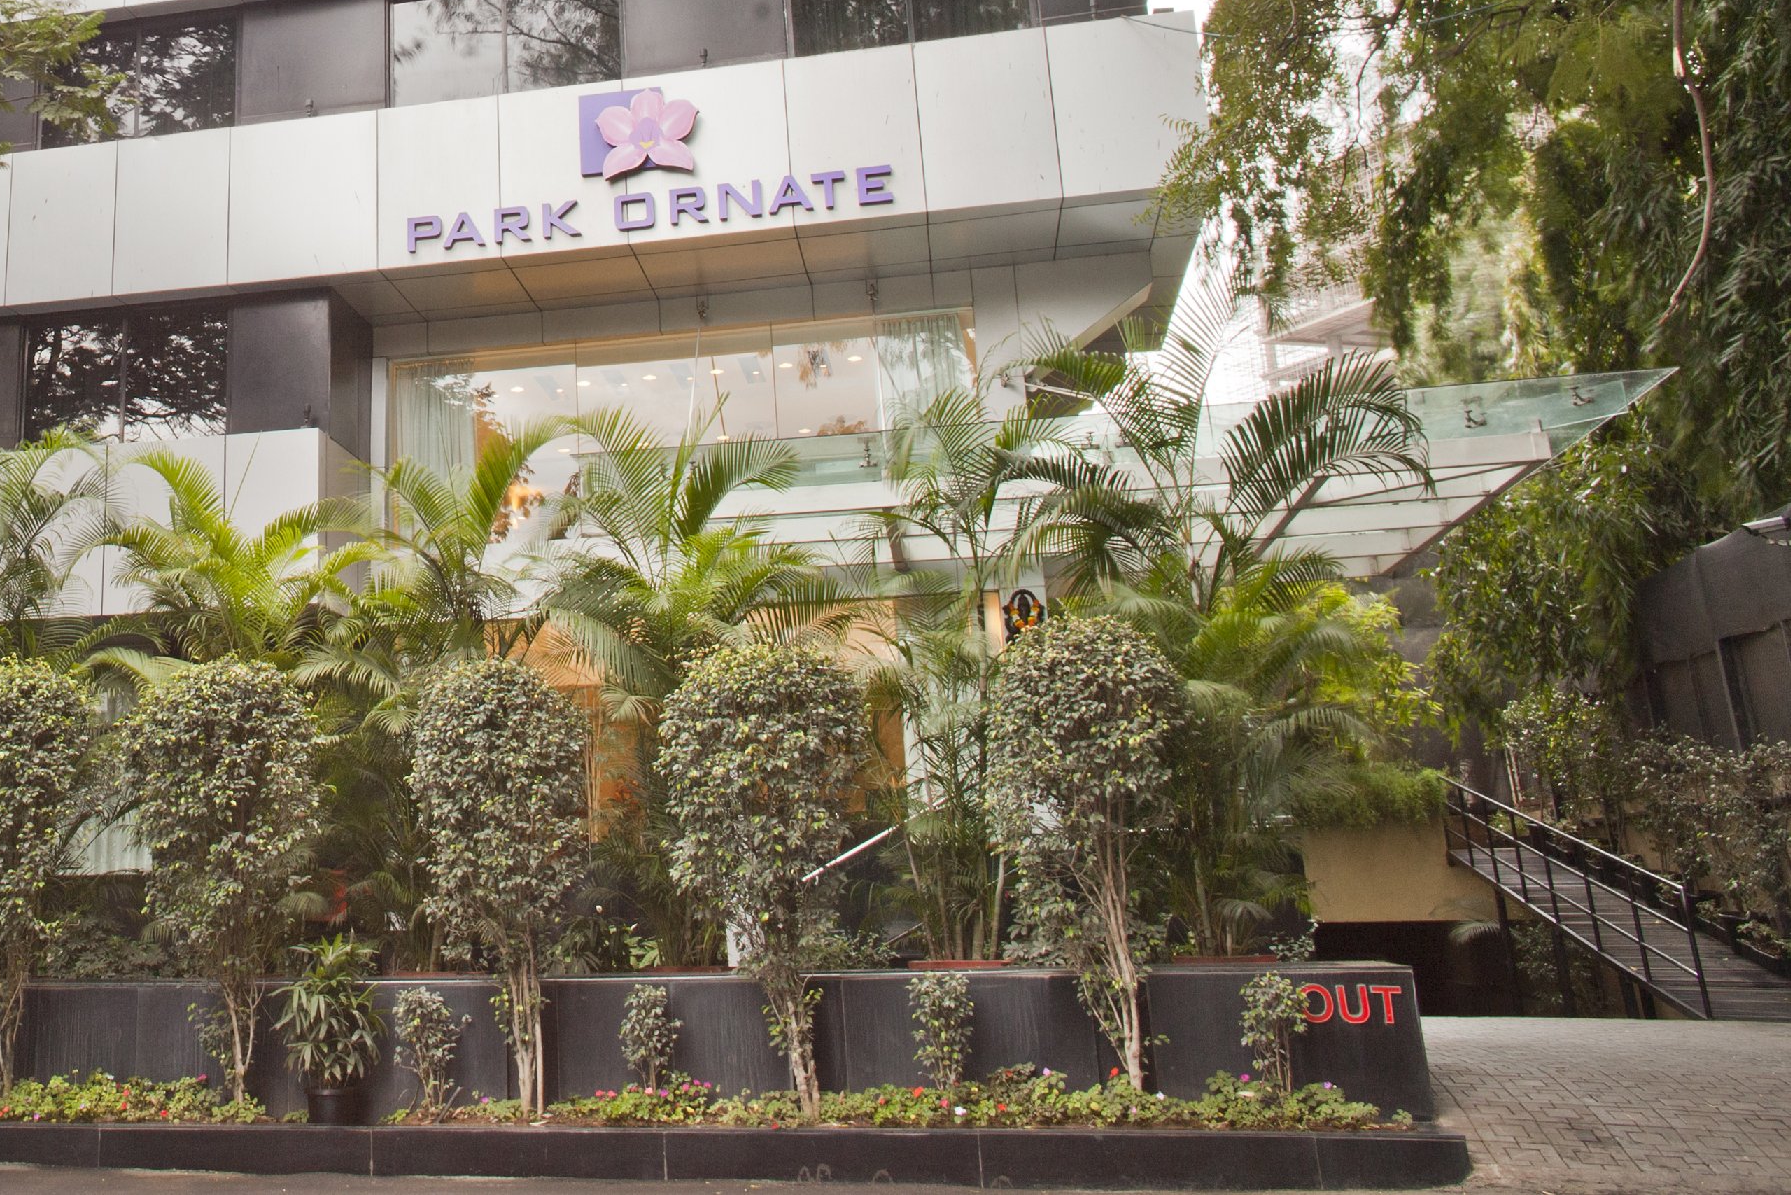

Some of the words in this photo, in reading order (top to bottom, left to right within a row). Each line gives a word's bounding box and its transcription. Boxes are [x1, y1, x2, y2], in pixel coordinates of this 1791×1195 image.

[407, 199, 582, 253] PARK
[613, 164, 894, 231] ORNATE
[1300, 984, 1402, 1025] OUT
